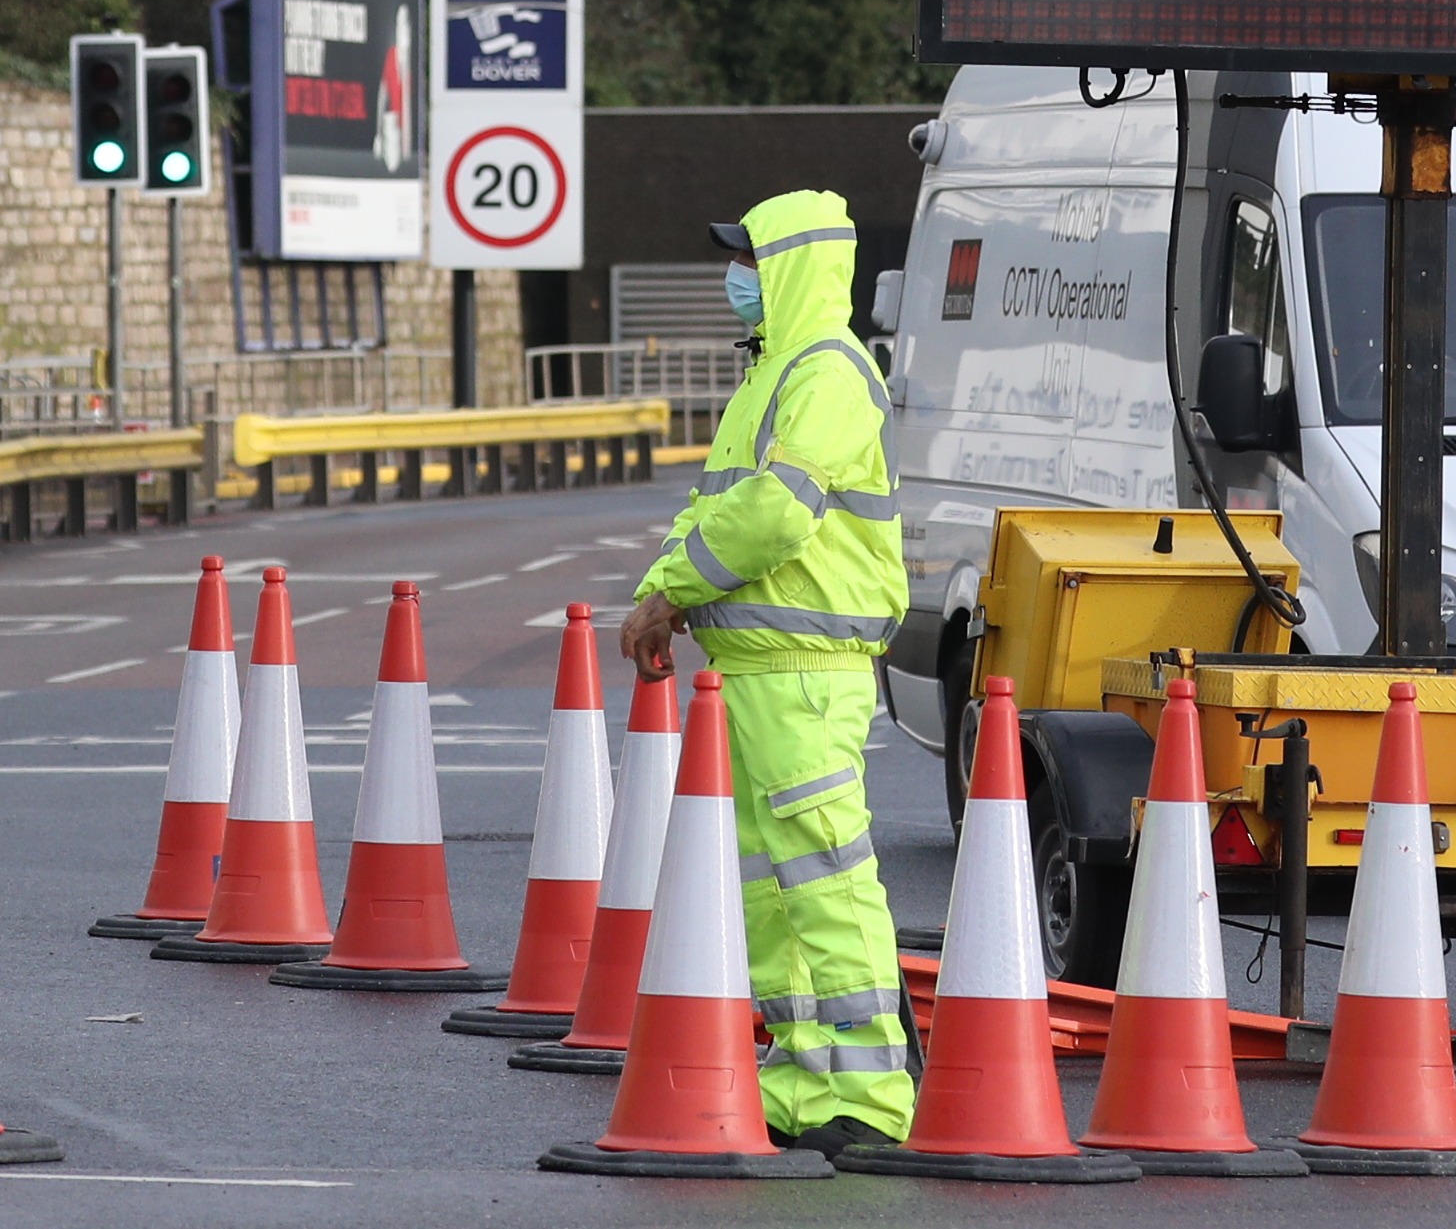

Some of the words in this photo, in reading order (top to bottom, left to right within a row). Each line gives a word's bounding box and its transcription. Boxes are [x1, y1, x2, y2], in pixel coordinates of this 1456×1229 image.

[471, 65, 542, 82] DOVER
[472, 163, 539, 209] 20
[1051, 190, 1105, 244] Mobile
[1002, 266, 1048, 318] CCTV
[1047, 267, 1132, 332] Operational
[1043, 344, 1072, 397] Unit
